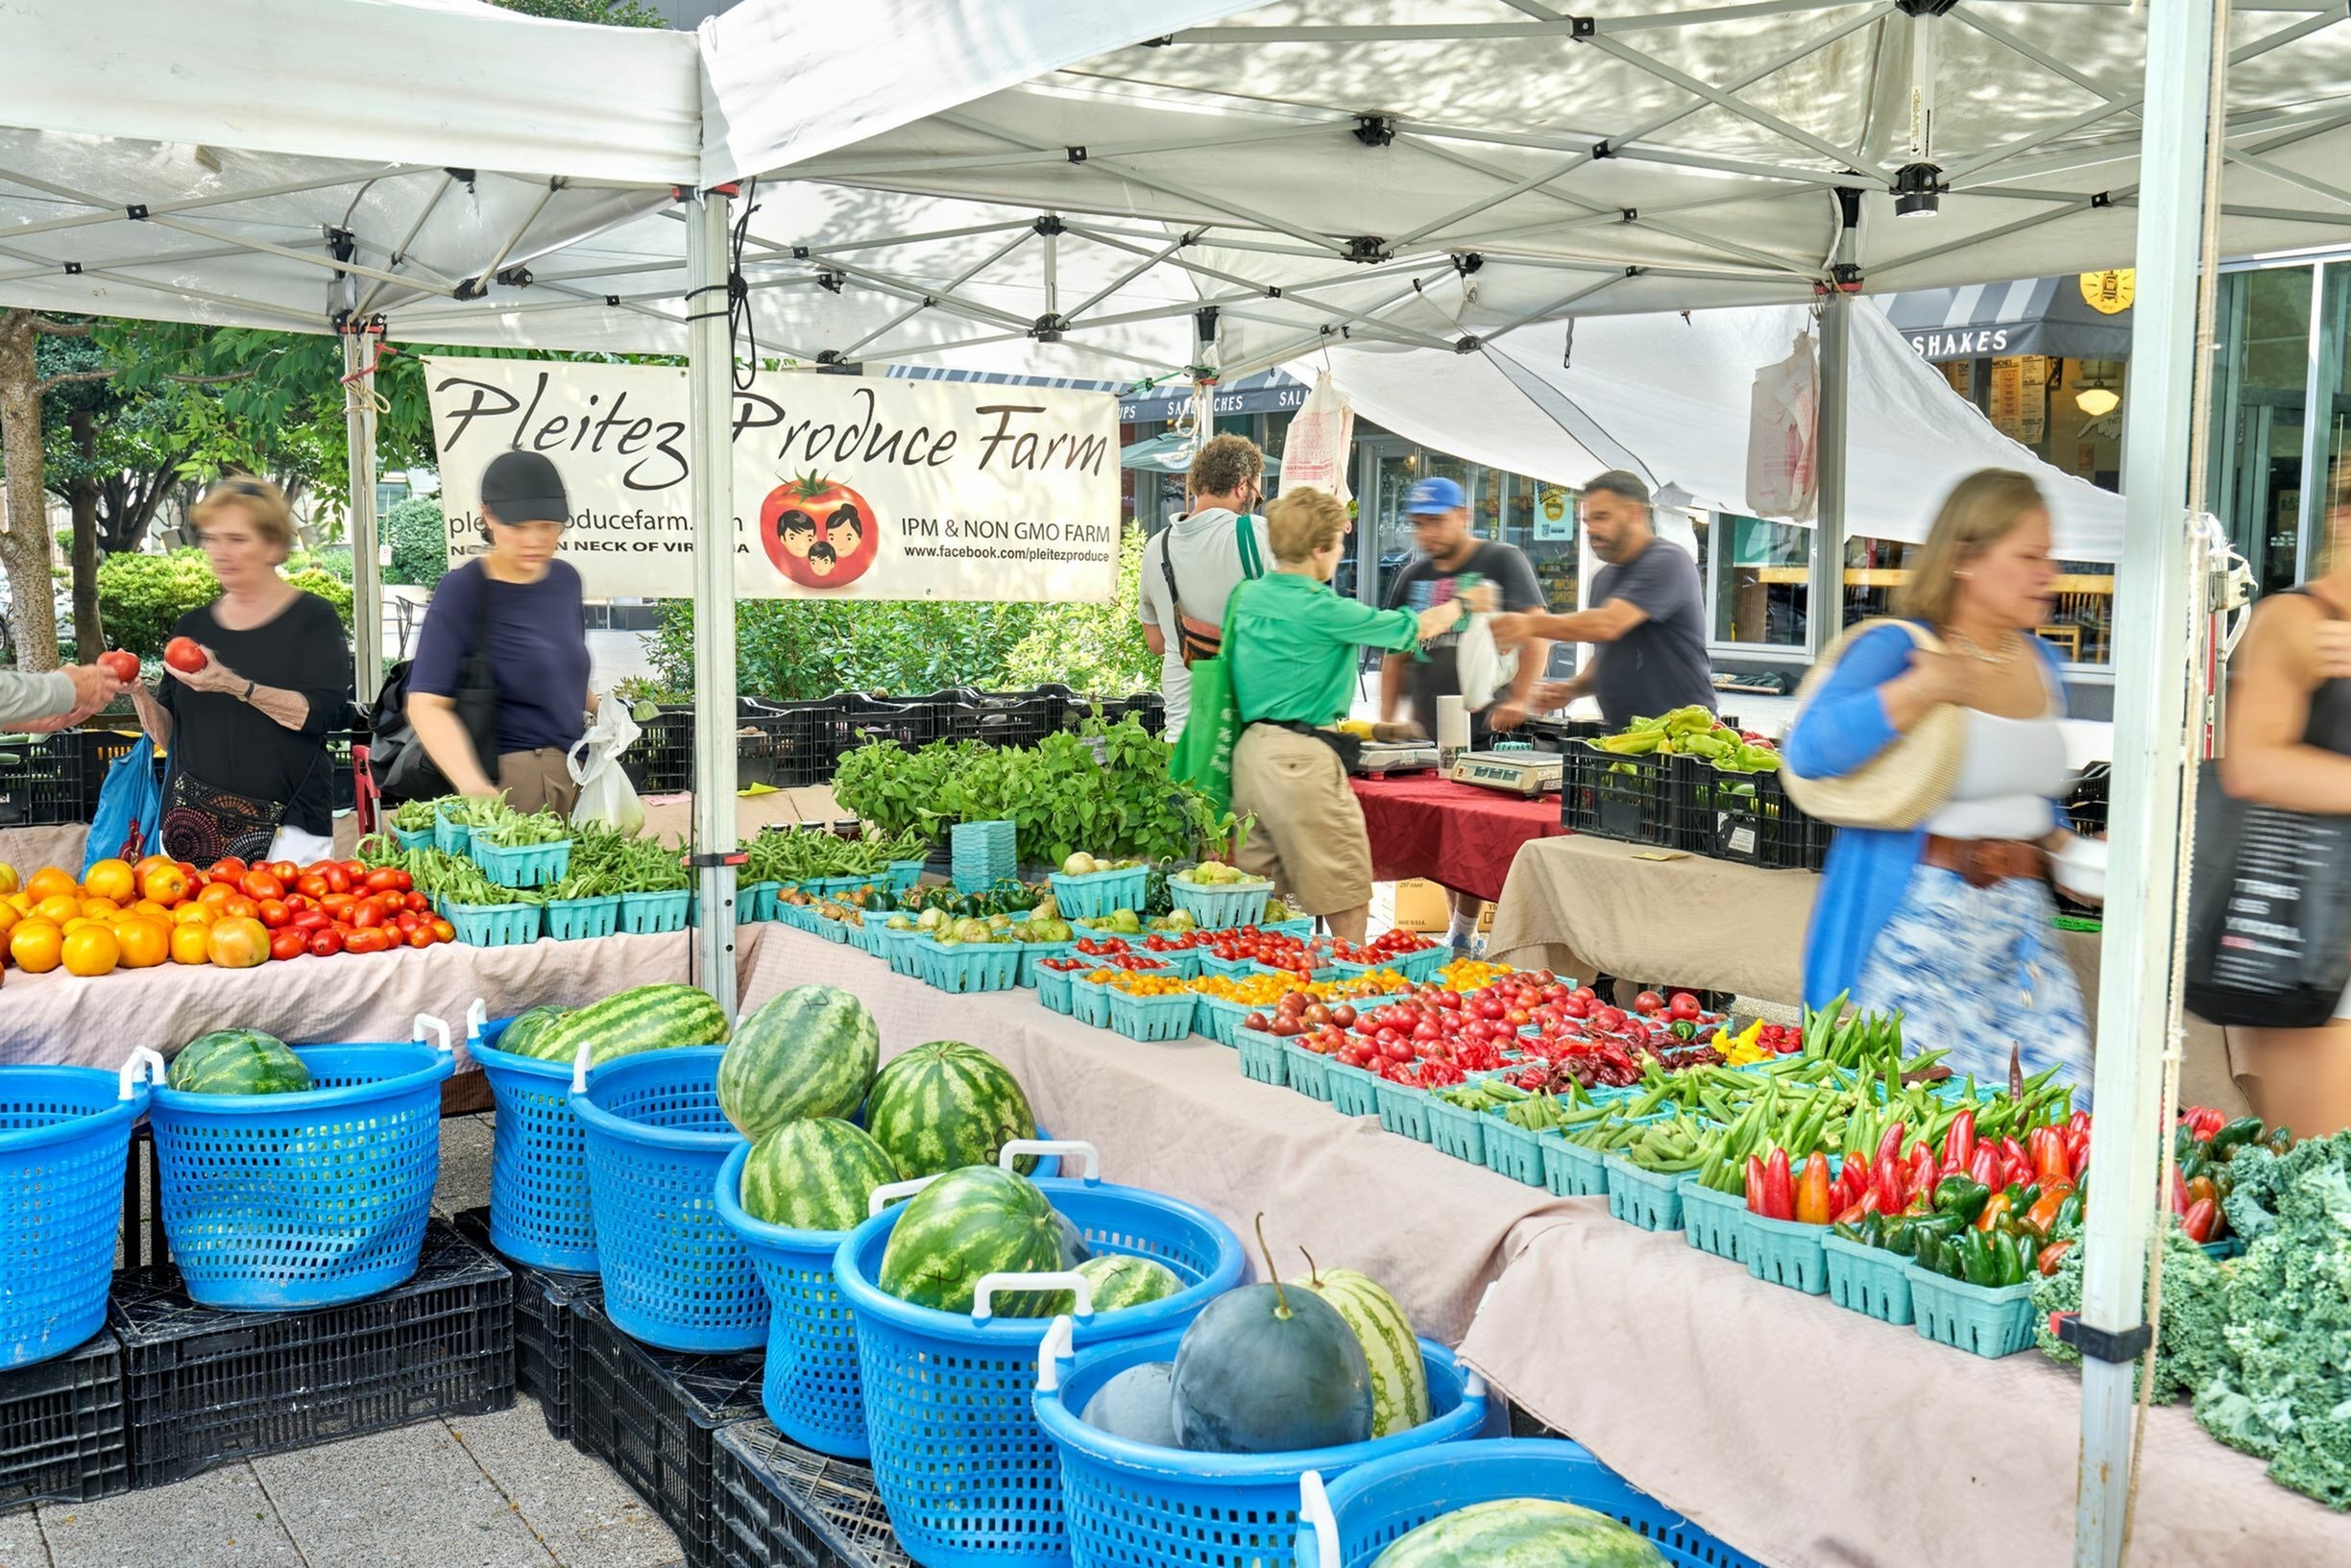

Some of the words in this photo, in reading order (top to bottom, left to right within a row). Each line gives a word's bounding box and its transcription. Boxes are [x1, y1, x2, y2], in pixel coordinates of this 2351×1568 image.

[1912, 329, 2007, 356] SHAKES
[1167, 395, 1243, 416] SANCHES
[435, 373, 689, 491] Pleitez
[732, 388, 957, 467] Produce
[976, 404, 1107, 476] Farm
[902, 518, 939, 537] IPM
[945, 519, 959, 538] &
[964, 519, 1008, 539] NON
[1014, 521, 1060, 541] GMO
[1065, 524, 1110, 543] FARM
[575, 541, 626, 552] NECK
[632, 541, 659, 552] OF
[664, 542, 750, 554] VIRA
[904, 545, 1109, 564] www.facebook.com/pleitezproduce
